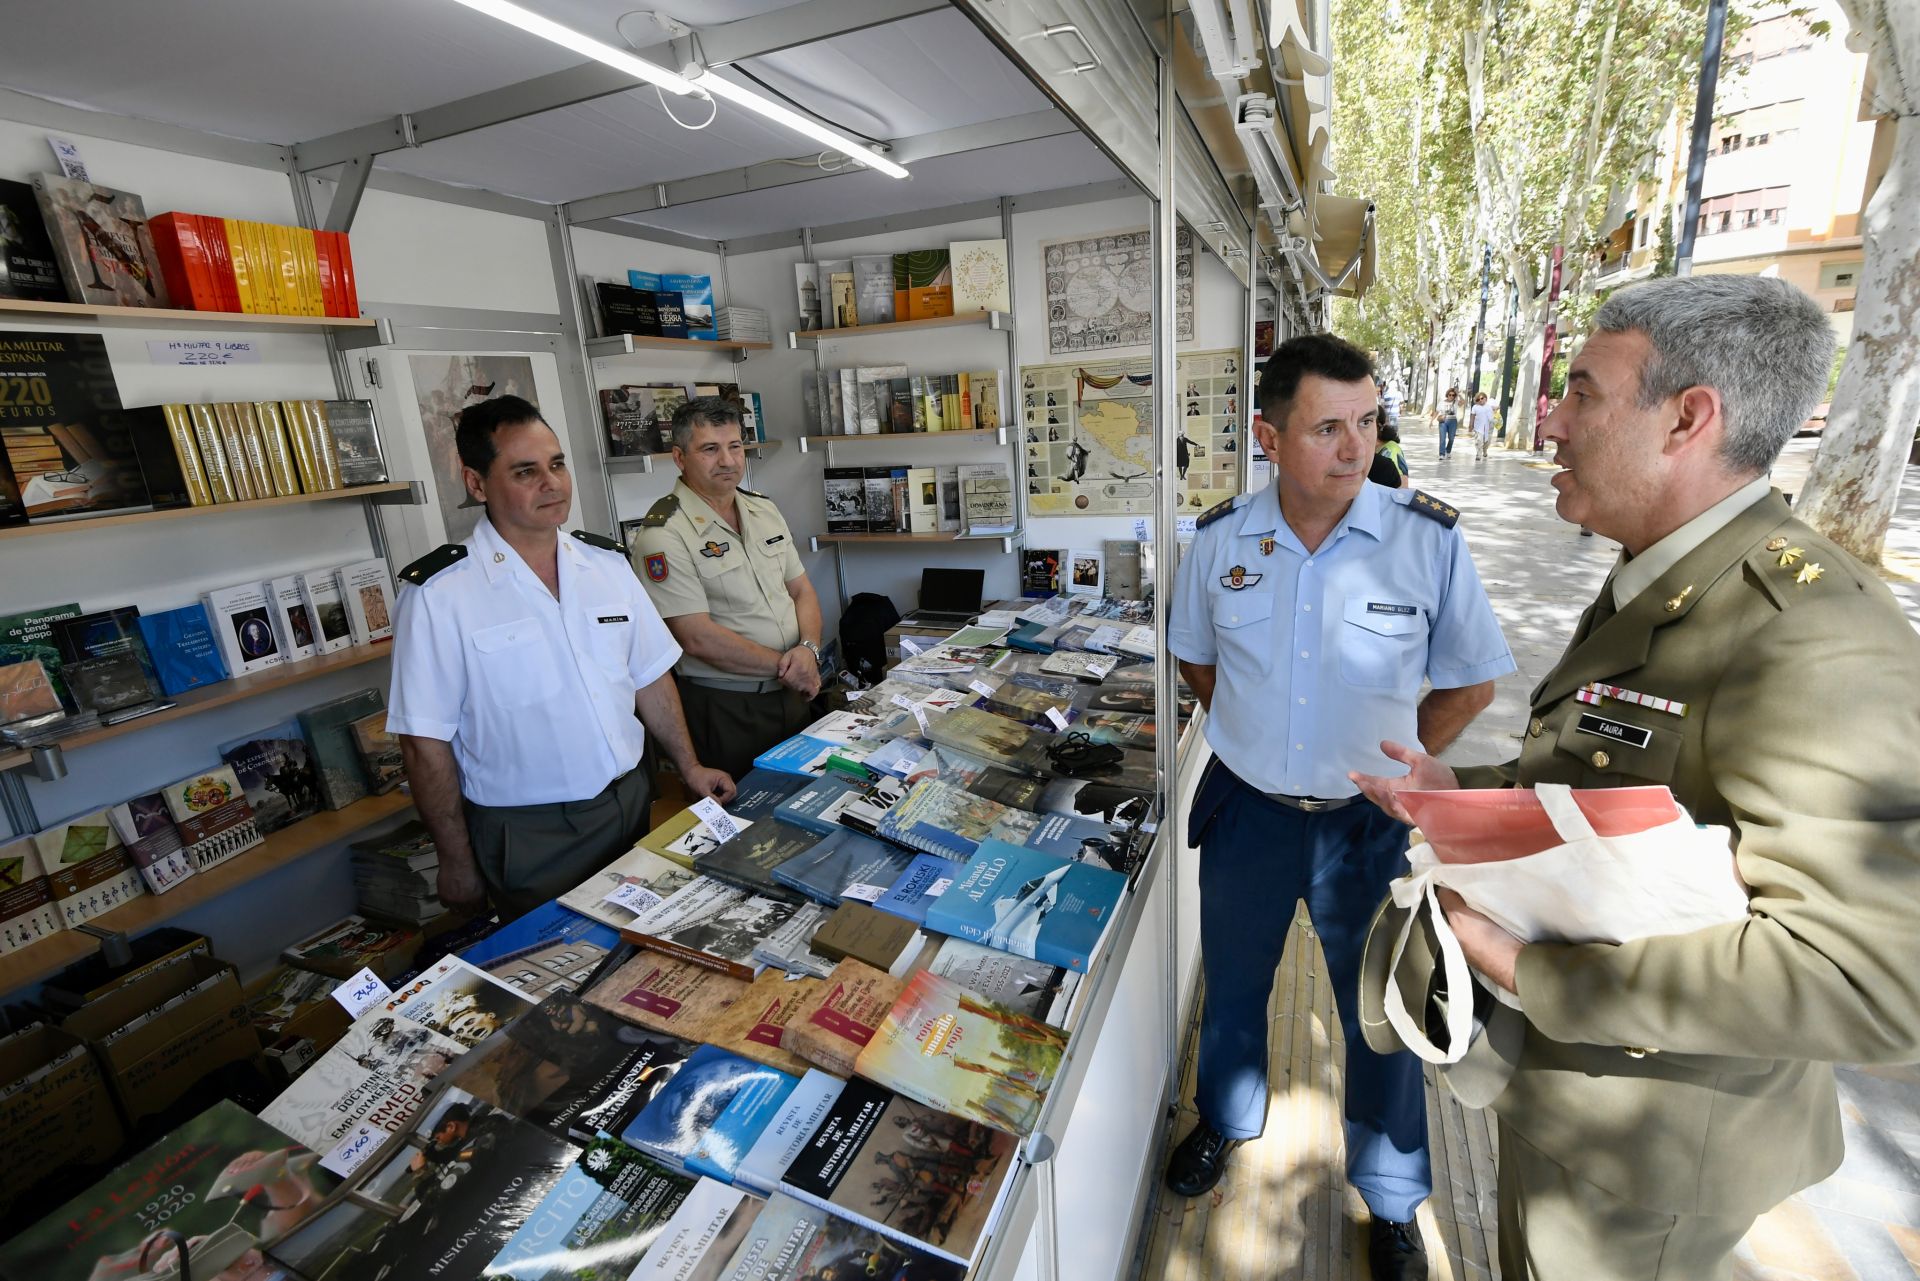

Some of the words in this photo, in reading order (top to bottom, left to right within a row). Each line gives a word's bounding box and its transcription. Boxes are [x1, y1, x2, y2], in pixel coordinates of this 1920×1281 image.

[14, 341, 65, 352] MILITAR
[184, 352, 219, 361] 220
[9, 628, 22, 637] de
[25, 612, 75, 626] Panorama
[1599, 723, 1623, 736] FAURA
[894, 894, 905, 902] EL
[902, 863, 932, 897] ROKISKI
[958, 861, 989, 892] Mirando
[968, 887, 986, 902] AL
[979, 858, 1007, 887] CIELO
[960, 924, 981, 936] cielo
[983, 974, 994, 990] EVA
[925, 1014, 954, 1057] amarillo
[946, 1026, 964, 1050] rojo
[368, 1082, 380, 1093] FOR
[380, 1071, 391, 1084] THE
[618, 1051, 656, 1092] GENERAL
[338, 1068, 384, 1113] DOCTRINE
[369, 1084, 416, 1125] RMED
[595, 1115, 611, 1130] DE
[608, 1082, 642, 1117] MARINA
[332, 1079, 394, 1139] EMPLOYMENT
[549, 1096, 591, 1128] MISIÓN:
[776, 1106, 800, 1136] REVISTA
[792, 1119, 803, 1129] DE
[342, 1136, 369, 1160] 21,60
[778, 1125, 811, 1167] HISTORIA
[806, 1093, 833, 1127] MILITAR
[816, 1116, 842, 1149] REVISTA
[818, 1138, 851, 1180] HISTORIA
[847, 1101, 875, 1143] MILITAR
[832, 1129, 844, 1142] DE
[347, 1137, 386, 1174] PUBLICACIÓN
[134, 1185, 185, 1221] 1920
[144, 1192, 196, 1231] 2020
[574, 1226, 585, 1236] LA
[583, 1191, 613, 1226] ACADEMIA
[609, 1162, 636, 1192] GENERAL
[576, 1219, 599, 1247] BÁSICA
[598, 1209, 607, 1221] DE
[605, 1165, 644, 1211] SUBOFICIALES
[622, 1211, 631, 1223] LA
[629, 1188, 651, 1215] FIGURA
[649, 1176, 662, 1191] DEL
[639, 1179, 669, 1215] SARGENTO
[677, 1191, 686, 1203] EL
[429, 1227, 480, 1275] MISIÓN:
[478, 1177, 523, 1225] LÍBANO
[697, 1207, 730, 1251] MILITAR
[773, 1218, 808, 1268] MILITAR
[656, 1227, 690, 1269] REVISTA
[677, 1244, 689, 1258] DE
[753, 1258, 770, 1276] DE
